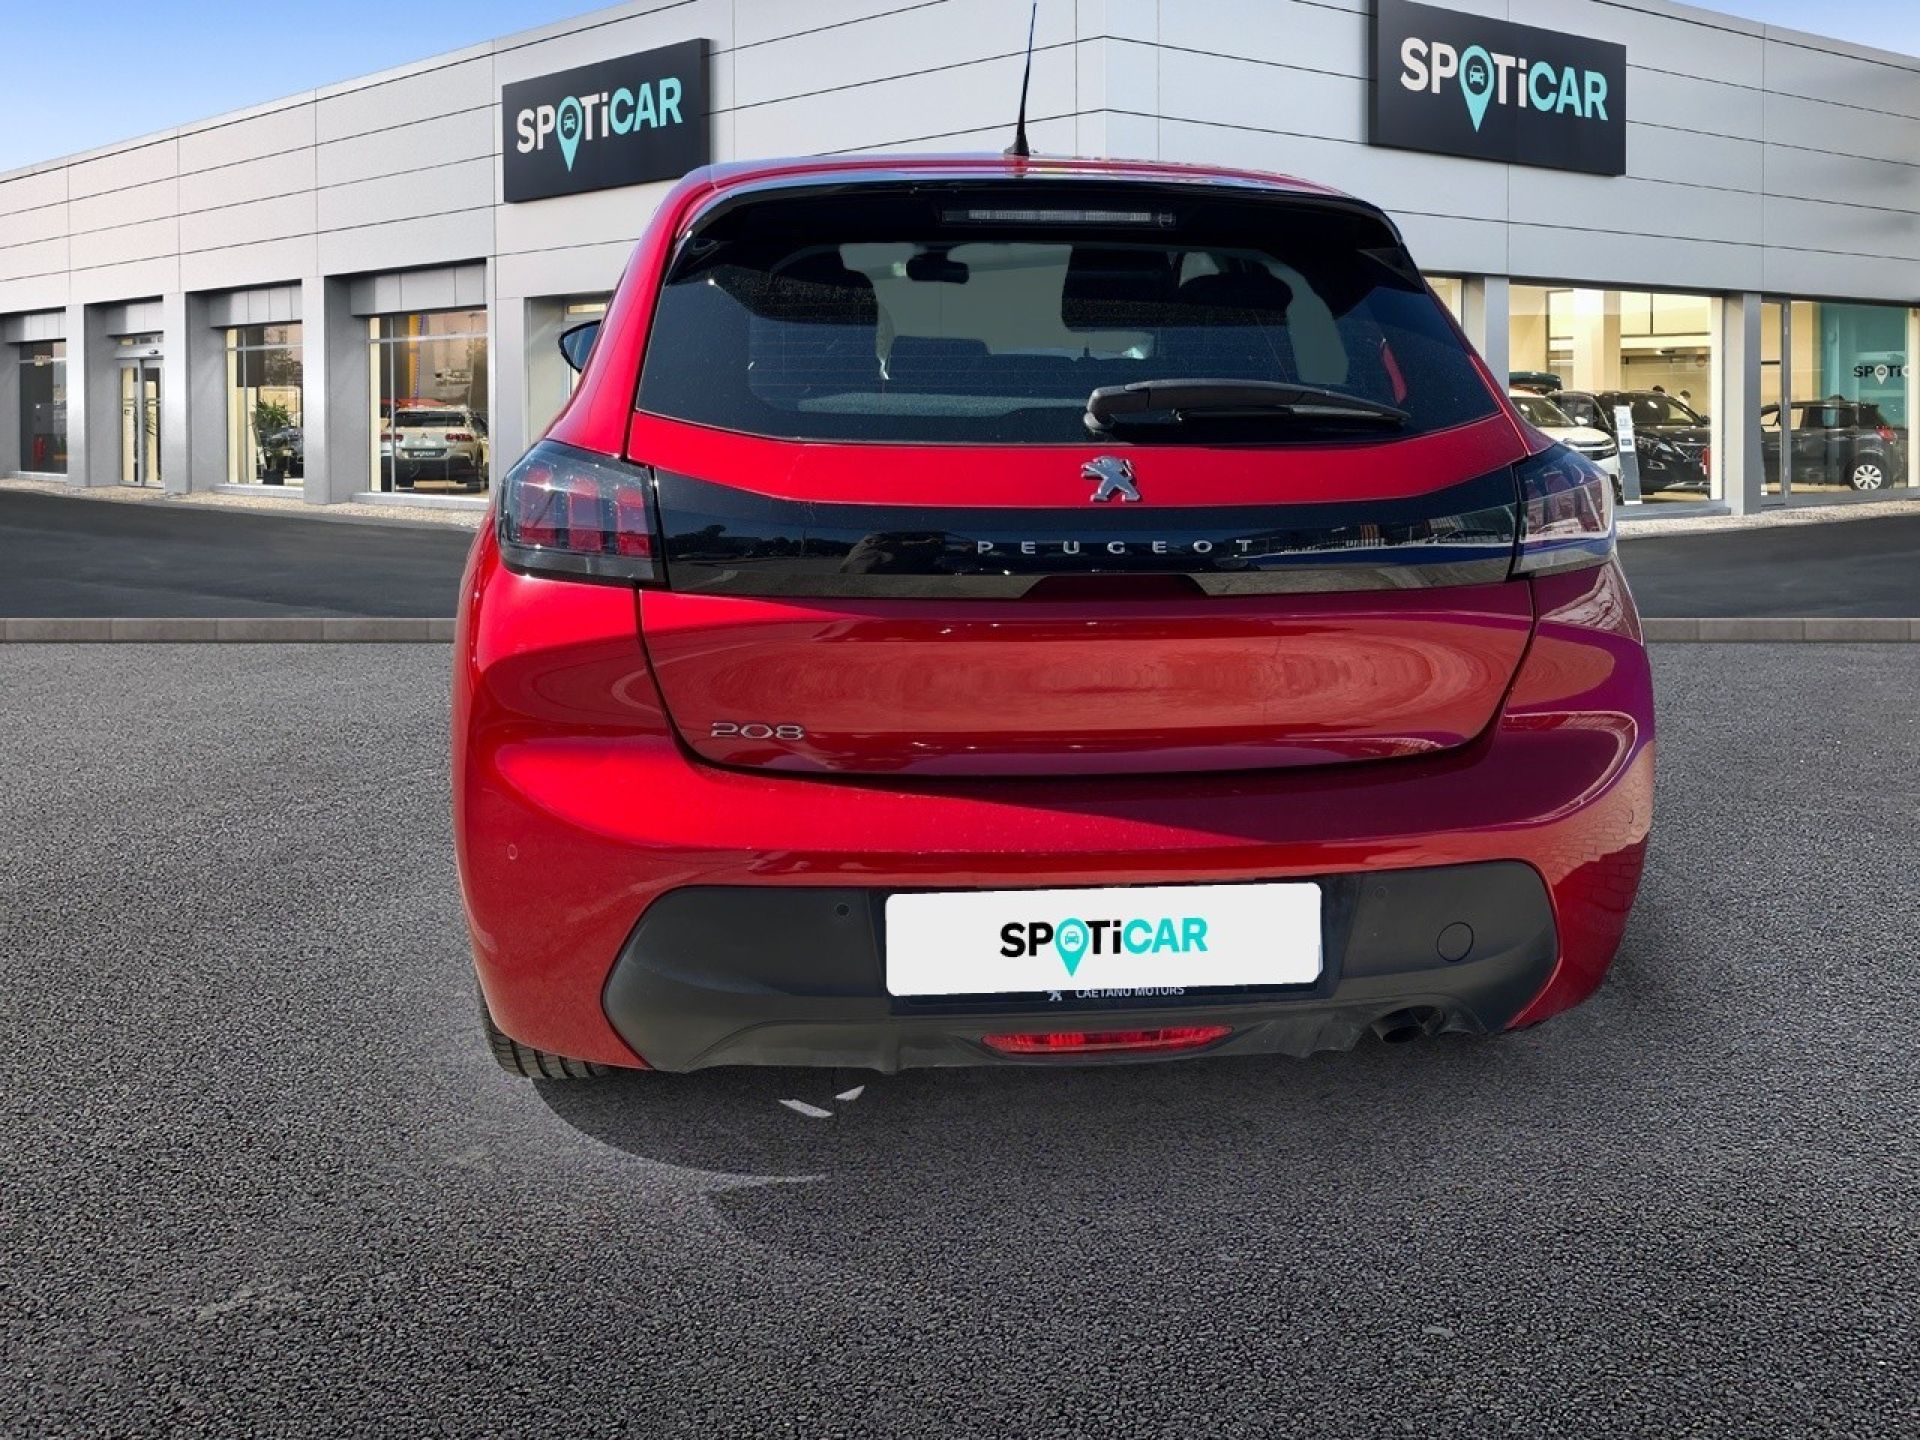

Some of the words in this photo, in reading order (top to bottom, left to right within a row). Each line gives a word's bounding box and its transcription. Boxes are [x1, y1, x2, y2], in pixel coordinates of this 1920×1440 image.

[977, 539, 1253, 555] PEUGEOT
[710, 722, 805, 740] 208
[1135, 986, 1185, 997] MOTORS
